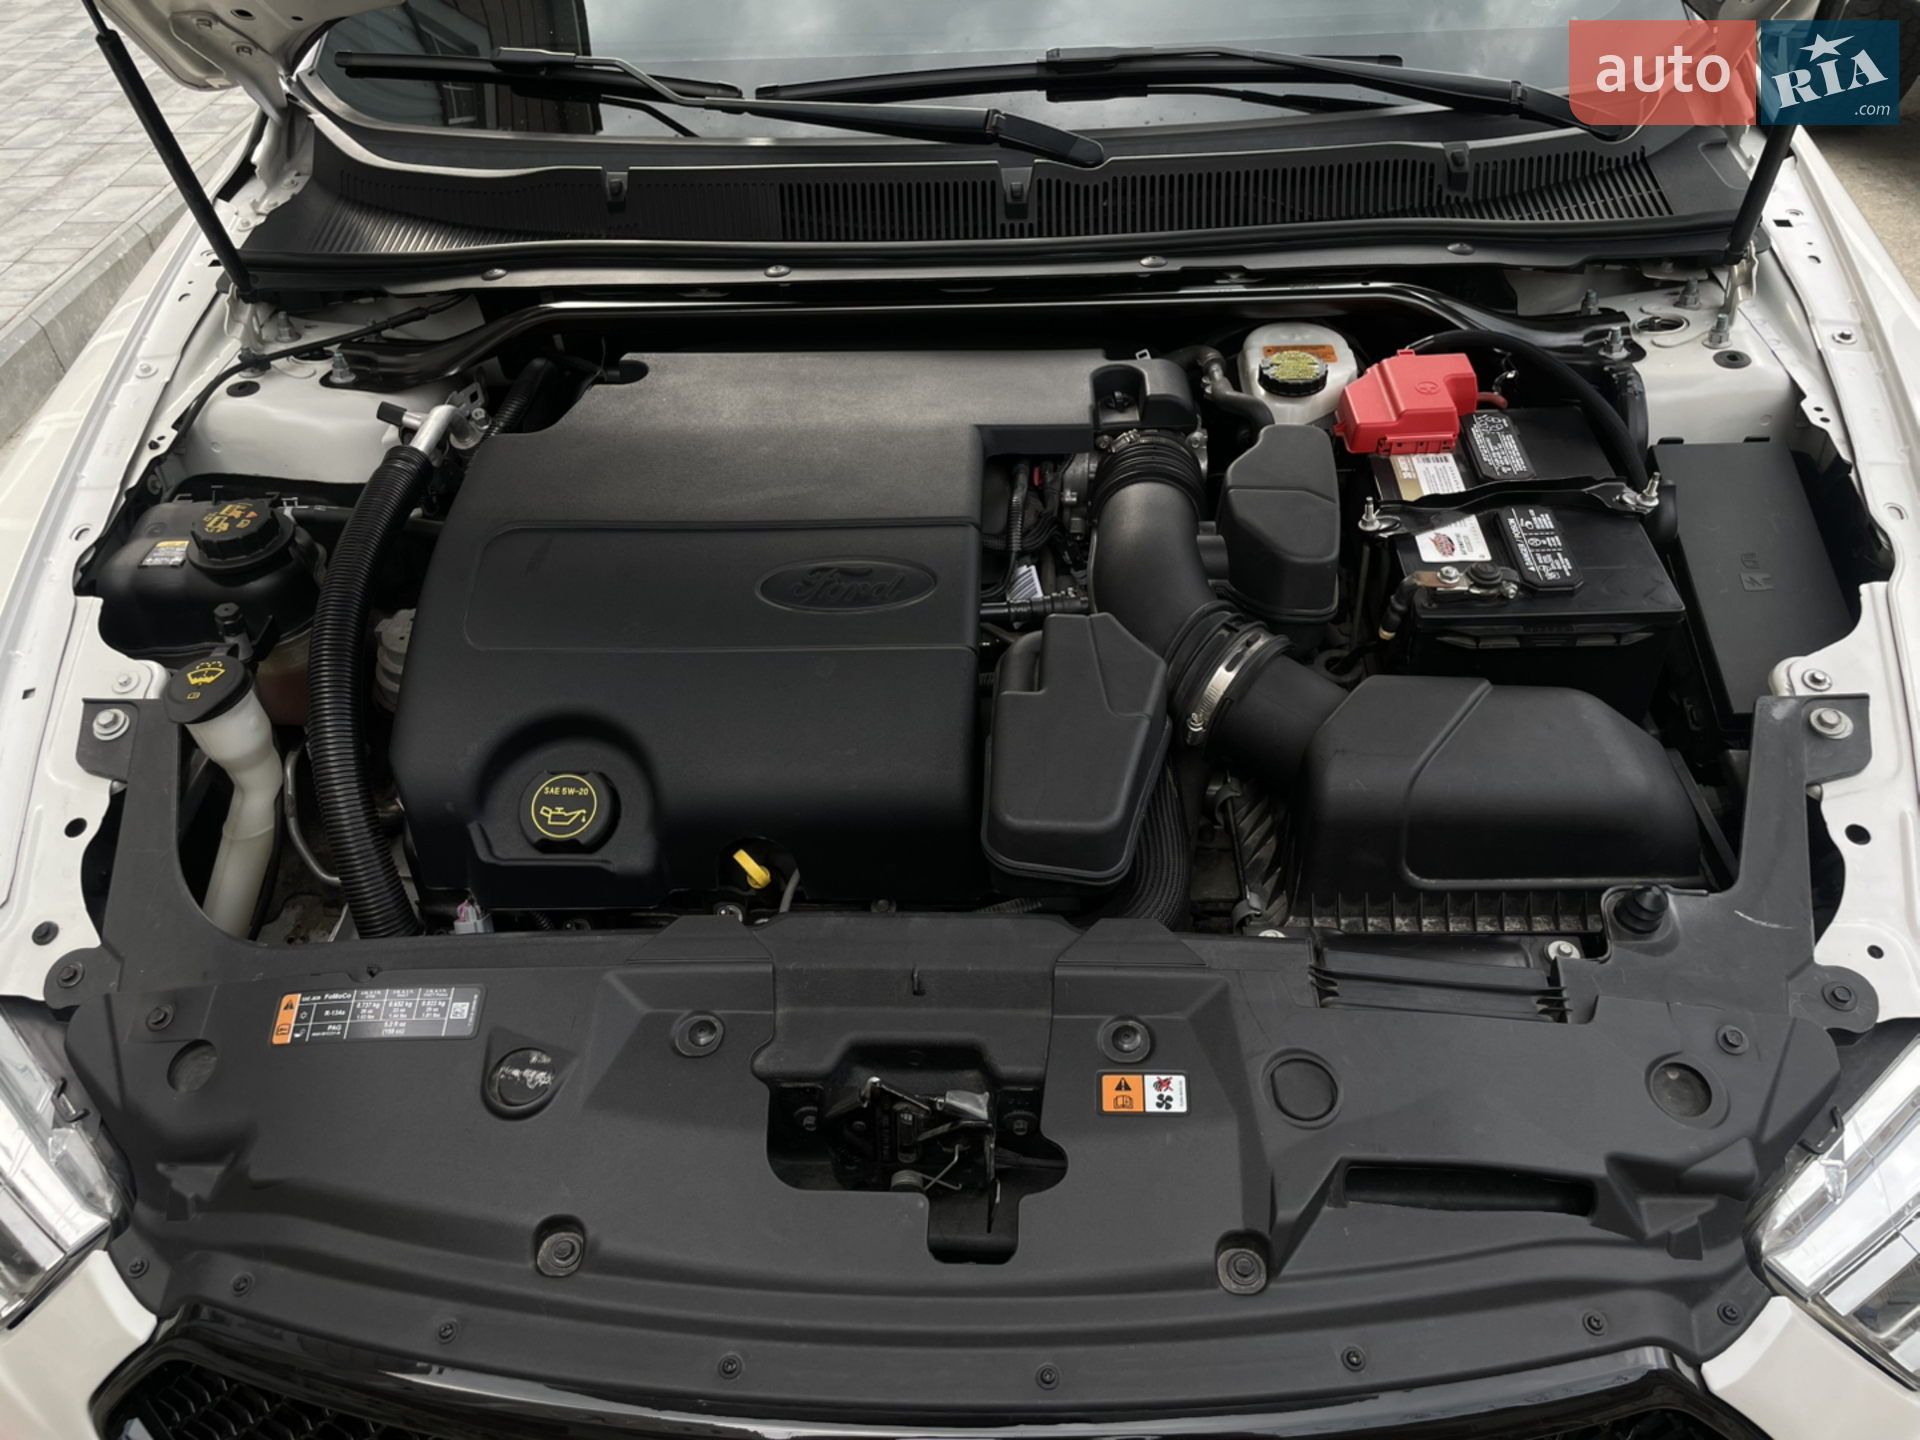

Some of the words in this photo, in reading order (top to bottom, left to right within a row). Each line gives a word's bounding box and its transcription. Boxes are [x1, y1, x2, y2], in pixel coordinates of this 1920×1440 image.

[793, 566, 905, 603] Ford
[544, 787, 560, 795] SAE
[561, 787, 588, 795] 5W-20
